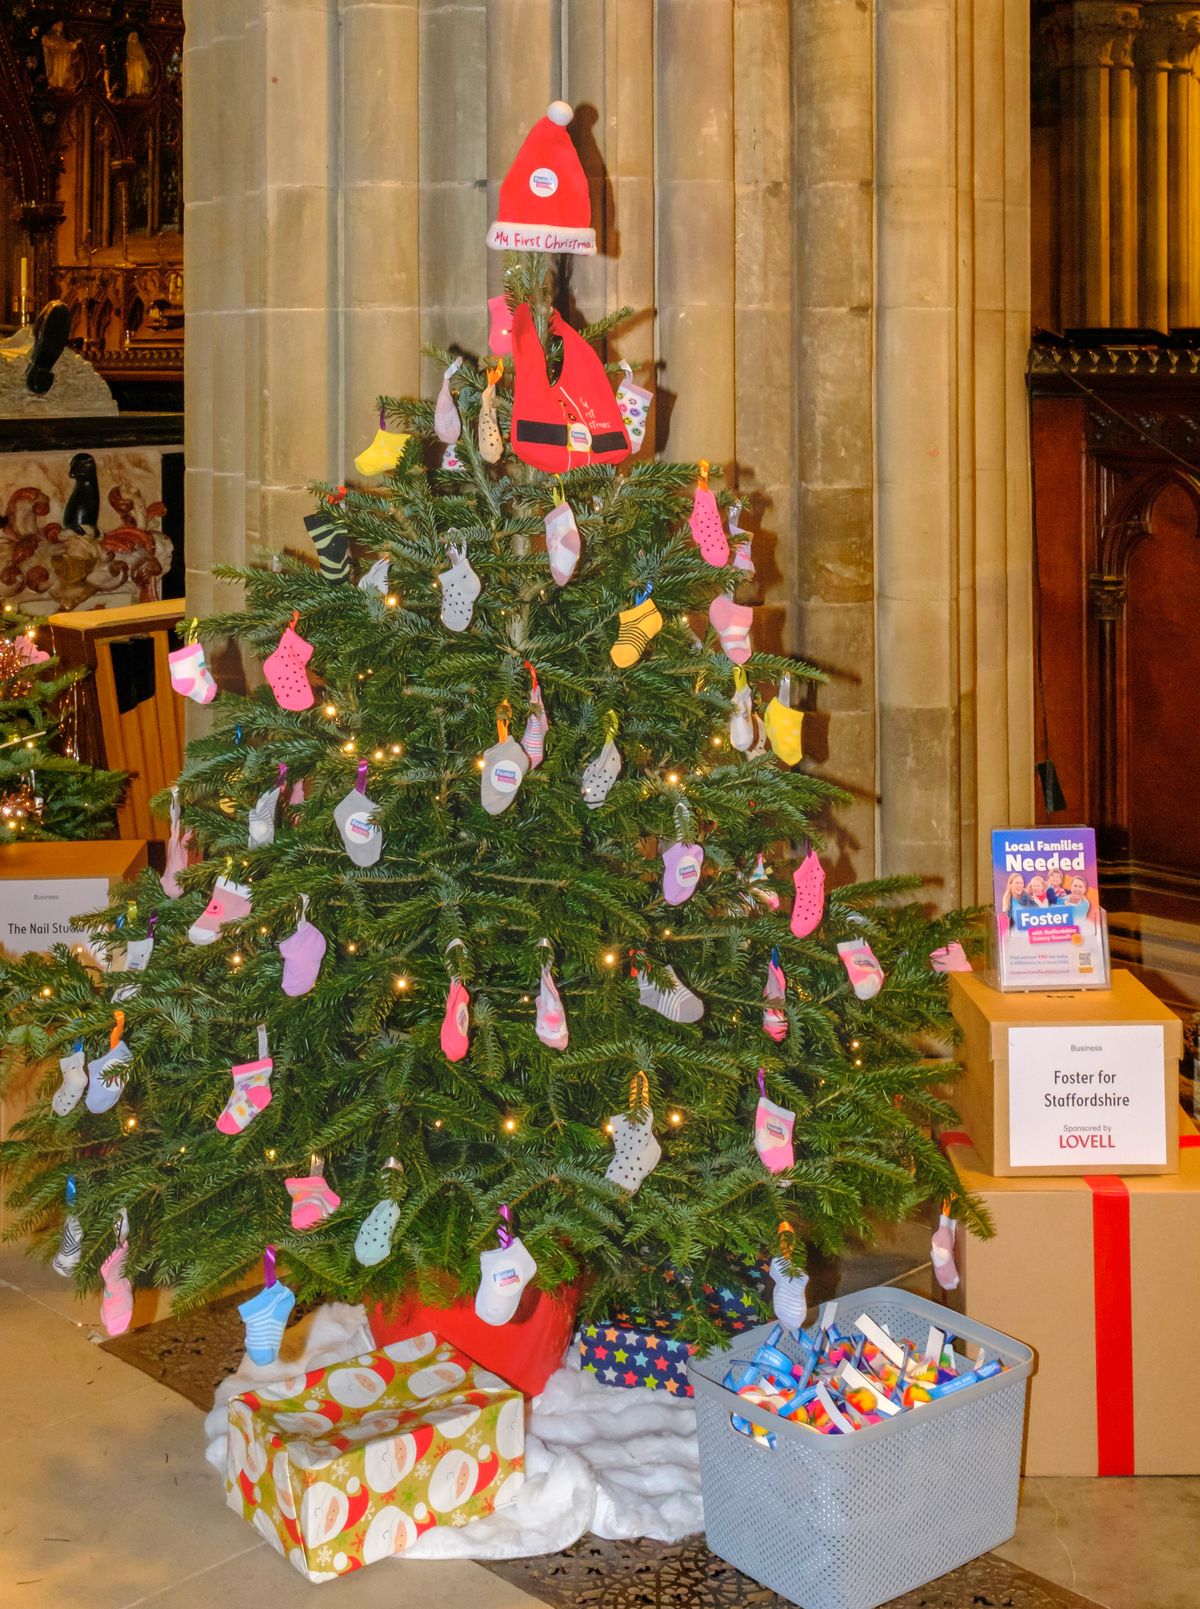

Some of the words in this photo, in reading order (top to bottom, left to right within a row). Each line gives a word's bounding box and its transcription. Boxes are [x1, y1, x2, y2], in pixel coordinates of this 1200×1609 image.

[494, 231, 509, 247] My
[513, 233, 541, 248] First
[1005, 840, 1035, 851] Local
[1036, 839, 1084, 851] Families
[1005, 852, 1085, 872] Needed
[1020, 912, 1069, 927] Foster
[7, 922, 27, 934] The
[29, 922, 50, 934] Nail
[1070, 1044, 1103, 1052] Business
[1053, 1070, 1094, 1084] Foster
[1098, 1069, 1117, 1084] for
[1044, 1092, 1130, 1108] Staffordshire
[1063, 1124, 1102, 1133] Sponsored
[1102, 1124, 1112, 1133] by
[1059, 1134, 1116, 1149] LOVELL
